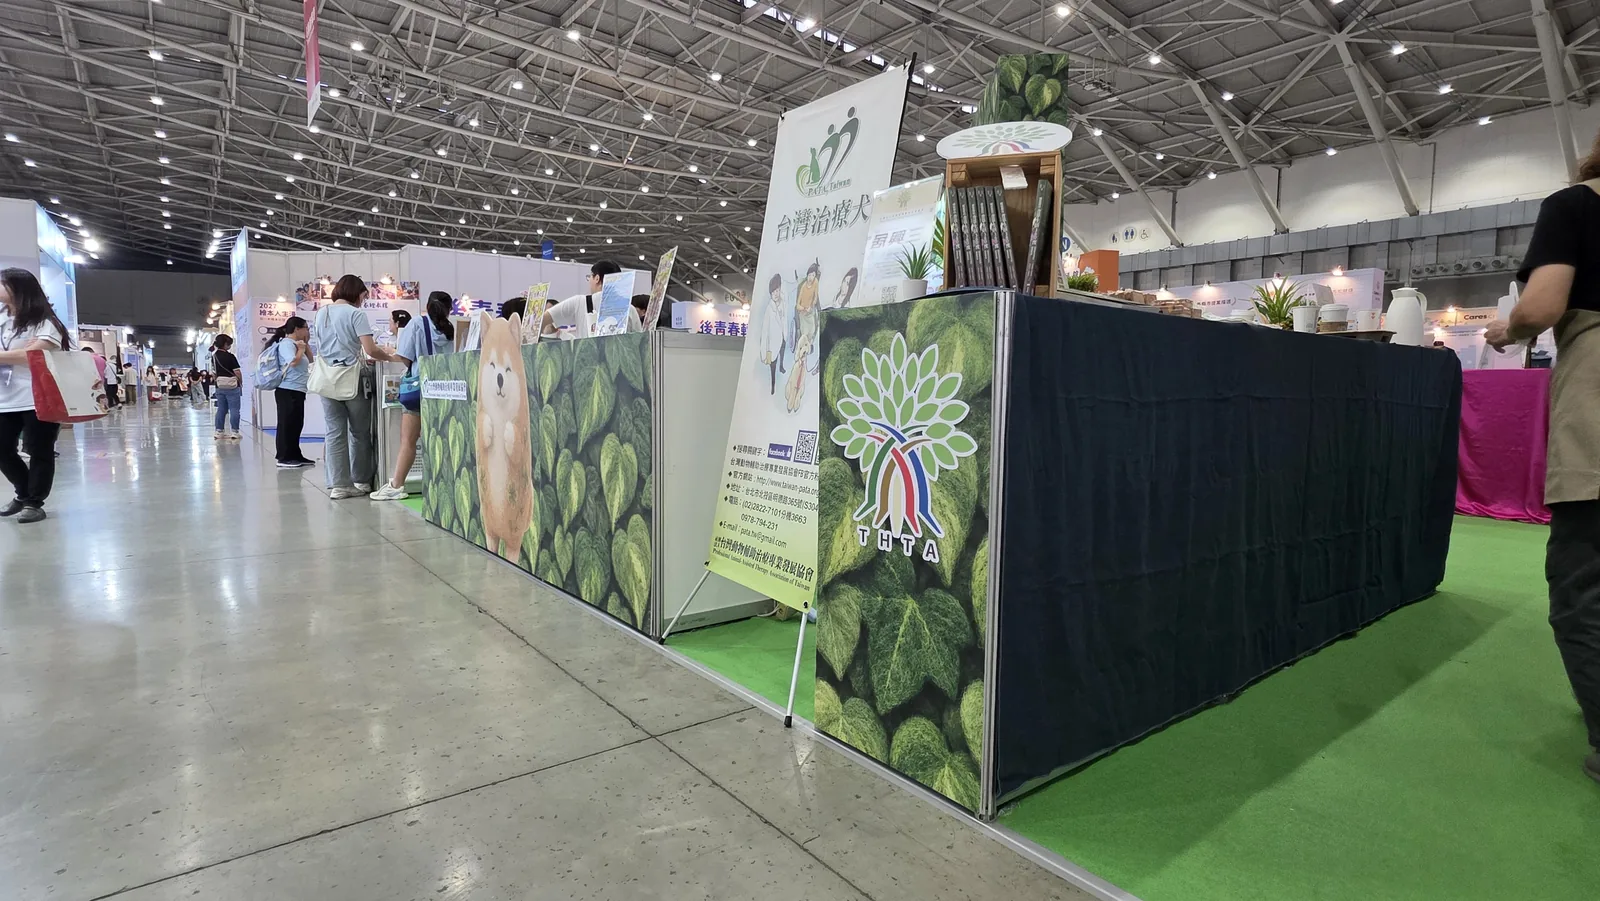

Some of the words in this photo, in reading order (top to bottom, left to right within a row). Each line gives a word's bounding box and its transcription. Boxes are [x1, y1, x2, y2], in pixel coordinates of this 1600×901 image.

[777, 194, 871, 242] 台灣治療犬
[741, 513, 778, 531] 0978-794-231
